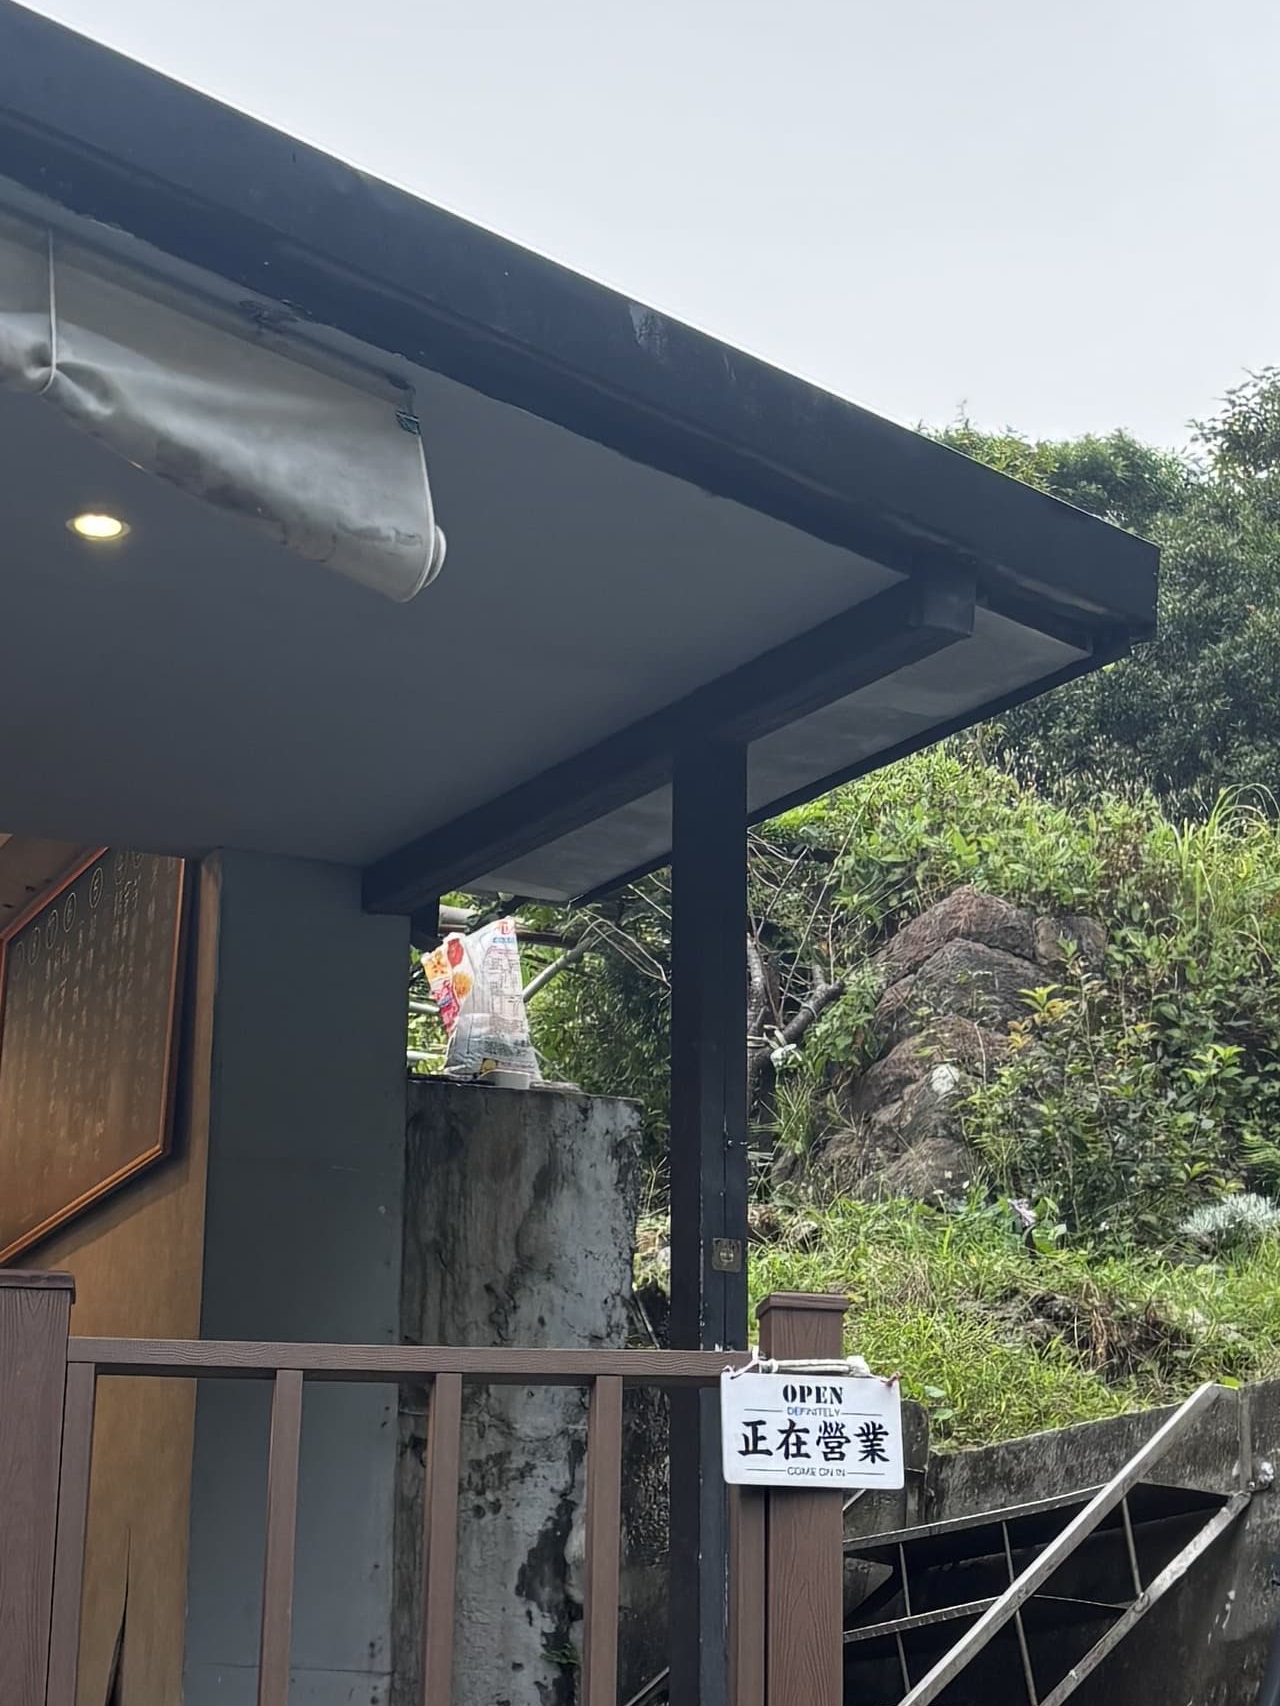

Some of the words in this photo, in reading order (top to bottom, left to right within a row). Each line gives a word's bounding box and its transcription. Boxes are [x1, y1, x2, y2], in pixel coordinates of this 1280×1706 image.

[783, 1384, 843, 1405] OPEN
[787, 1407, 840, 1417] DEFINITELY
[737, 1418, 890, 1464] 正在營業
[787, 1467, 816, 1476] COME
[818, 1468, 833, 1477] ON
[835, 1469, 846, 1477] IN
